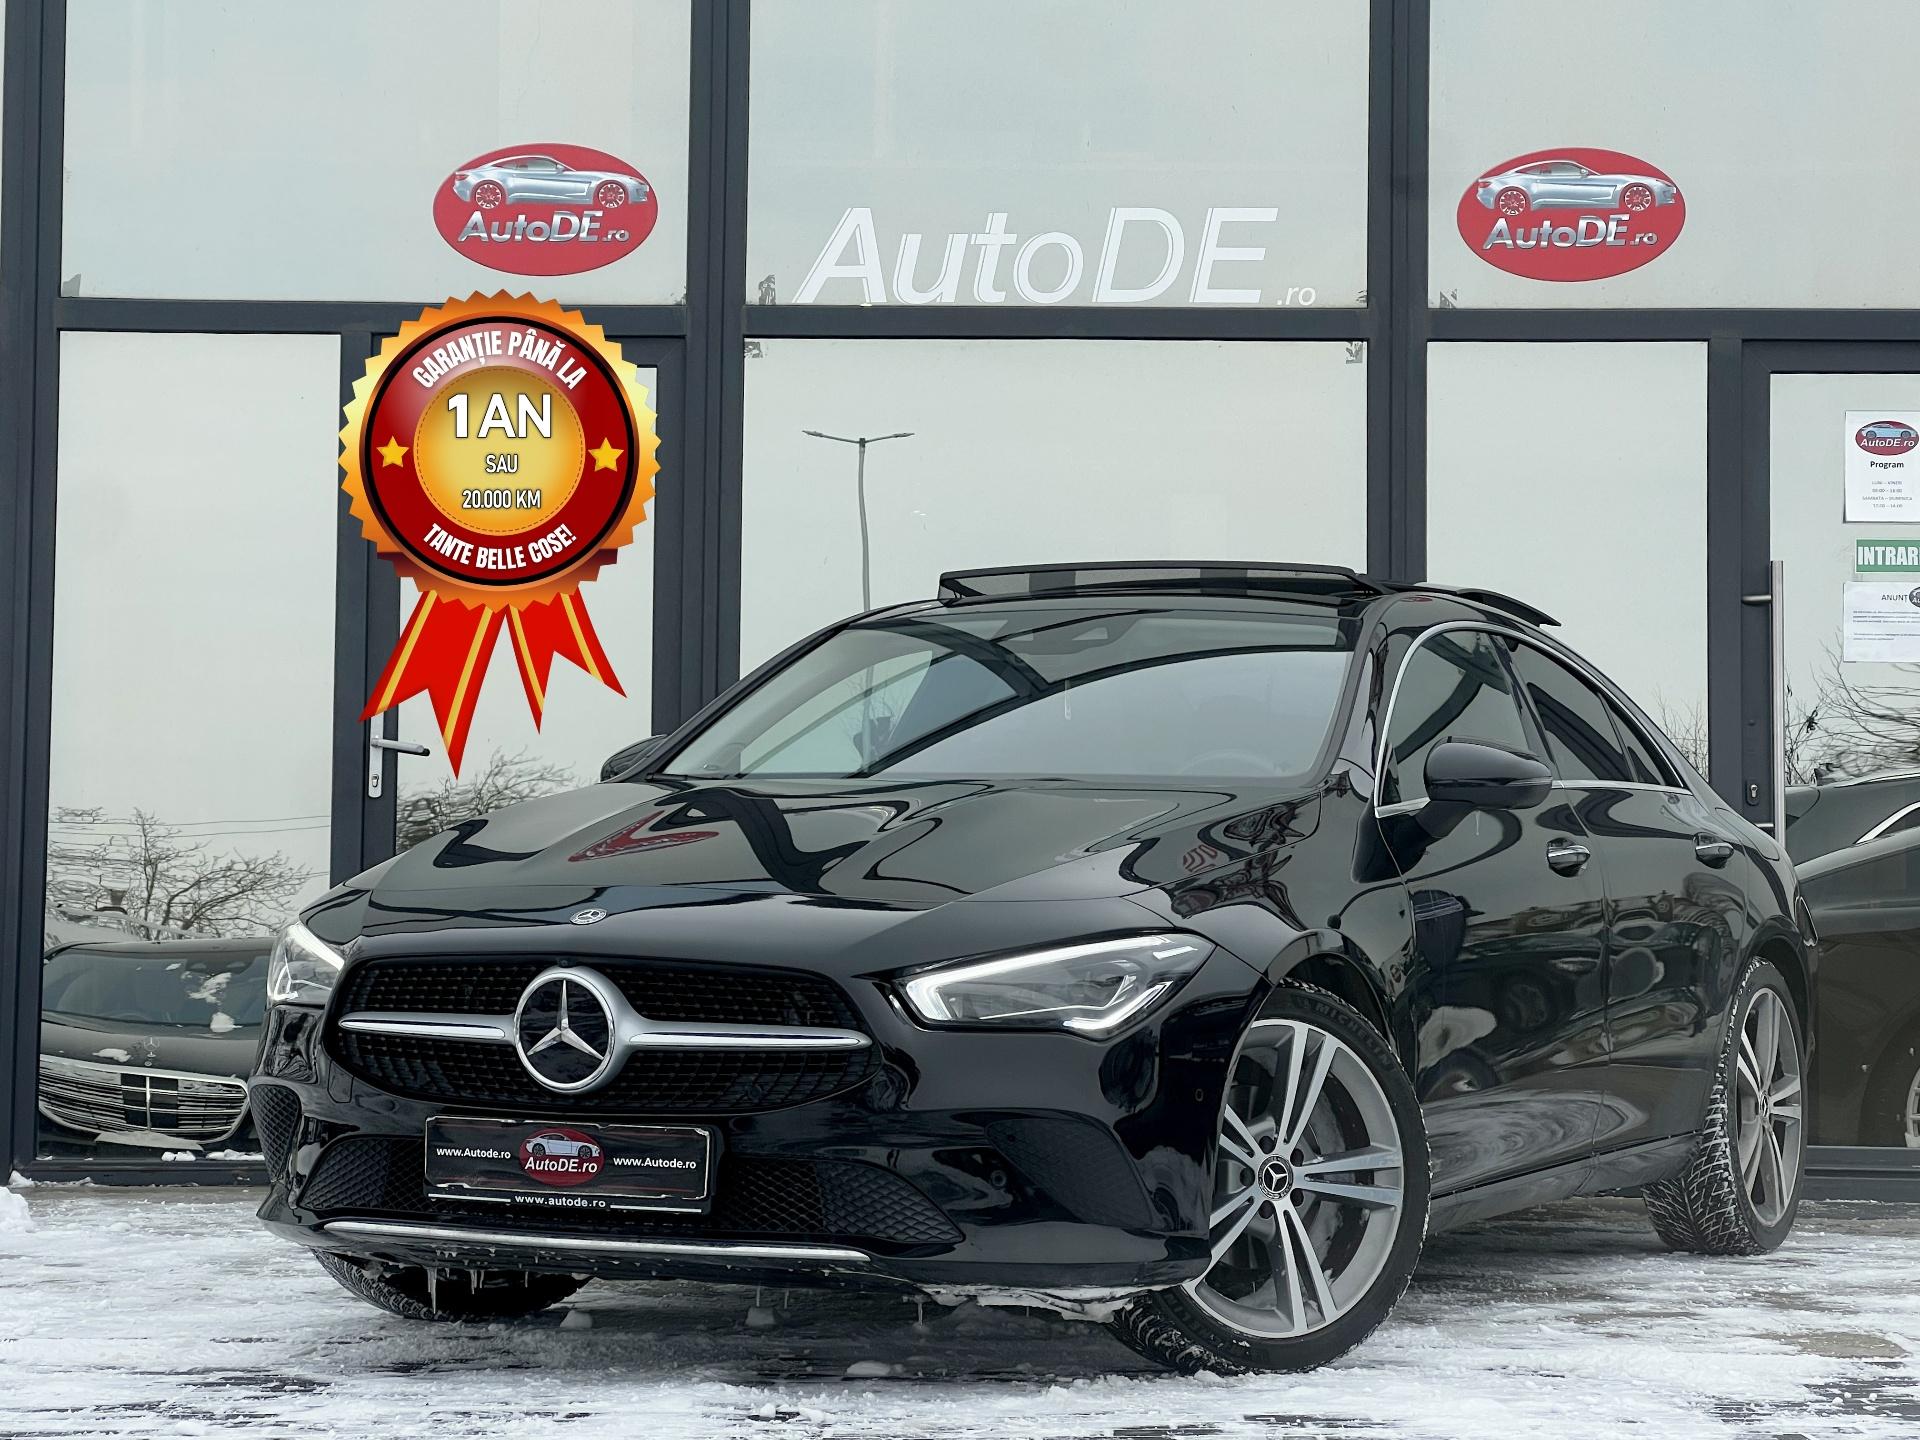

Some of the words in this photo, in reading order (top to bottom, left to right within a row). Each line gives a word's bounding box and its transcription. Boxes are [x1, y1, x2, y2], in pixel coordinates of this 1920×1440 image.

[1860, 438, 1915, 447] AutoDE.ro
[1870, 460, 1905, 470] Program
[1857, 546, 1920, 566] INTRAR
[436, 1146, 511, 1160] www.Autode.ro
[524, 1156, 598, 1174] AutoDE.ro
[613, 1156, 697, 1170] www.Autode.ro
[514, 1193, 606, 1209] www.autode.ro
